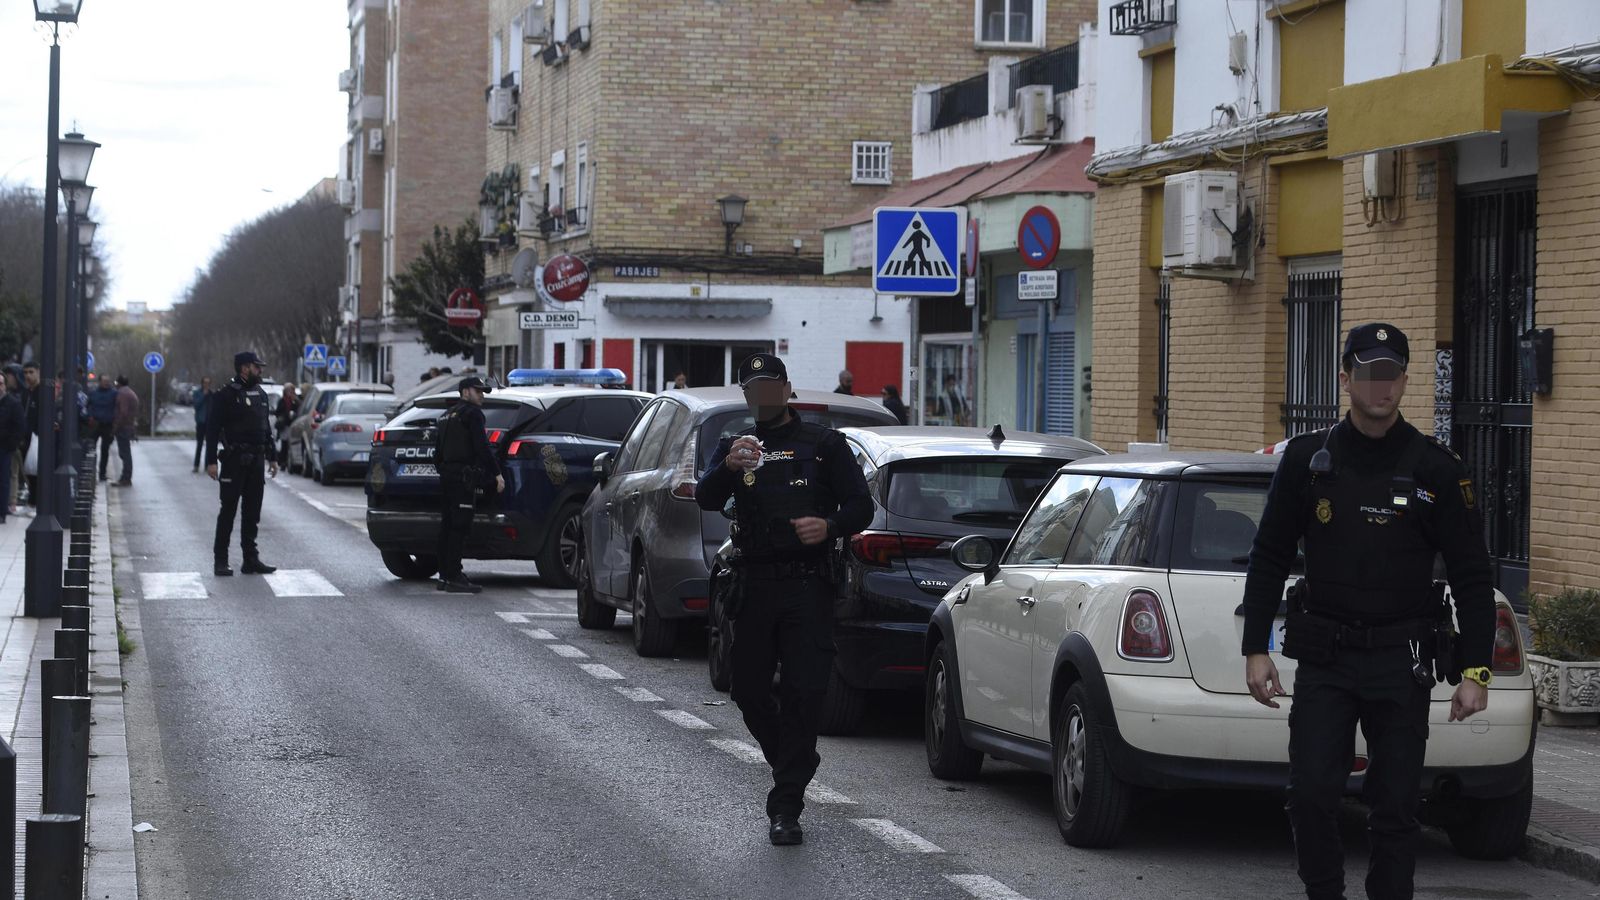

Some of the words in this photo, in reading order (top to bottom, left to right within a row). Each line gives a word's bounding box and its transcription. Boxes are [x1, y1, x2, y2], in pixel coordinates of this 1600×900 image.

[614, 266, 658, 277] PASAJES
[547, 270, 588, 294] Cruzcampo
[546, 314, 575, 322] DEMO
[395, 448, 435, 457] POLIC
[761, 450, 785, 458] OLICIA
[1360, 506, 1398, 515] POLICIA
